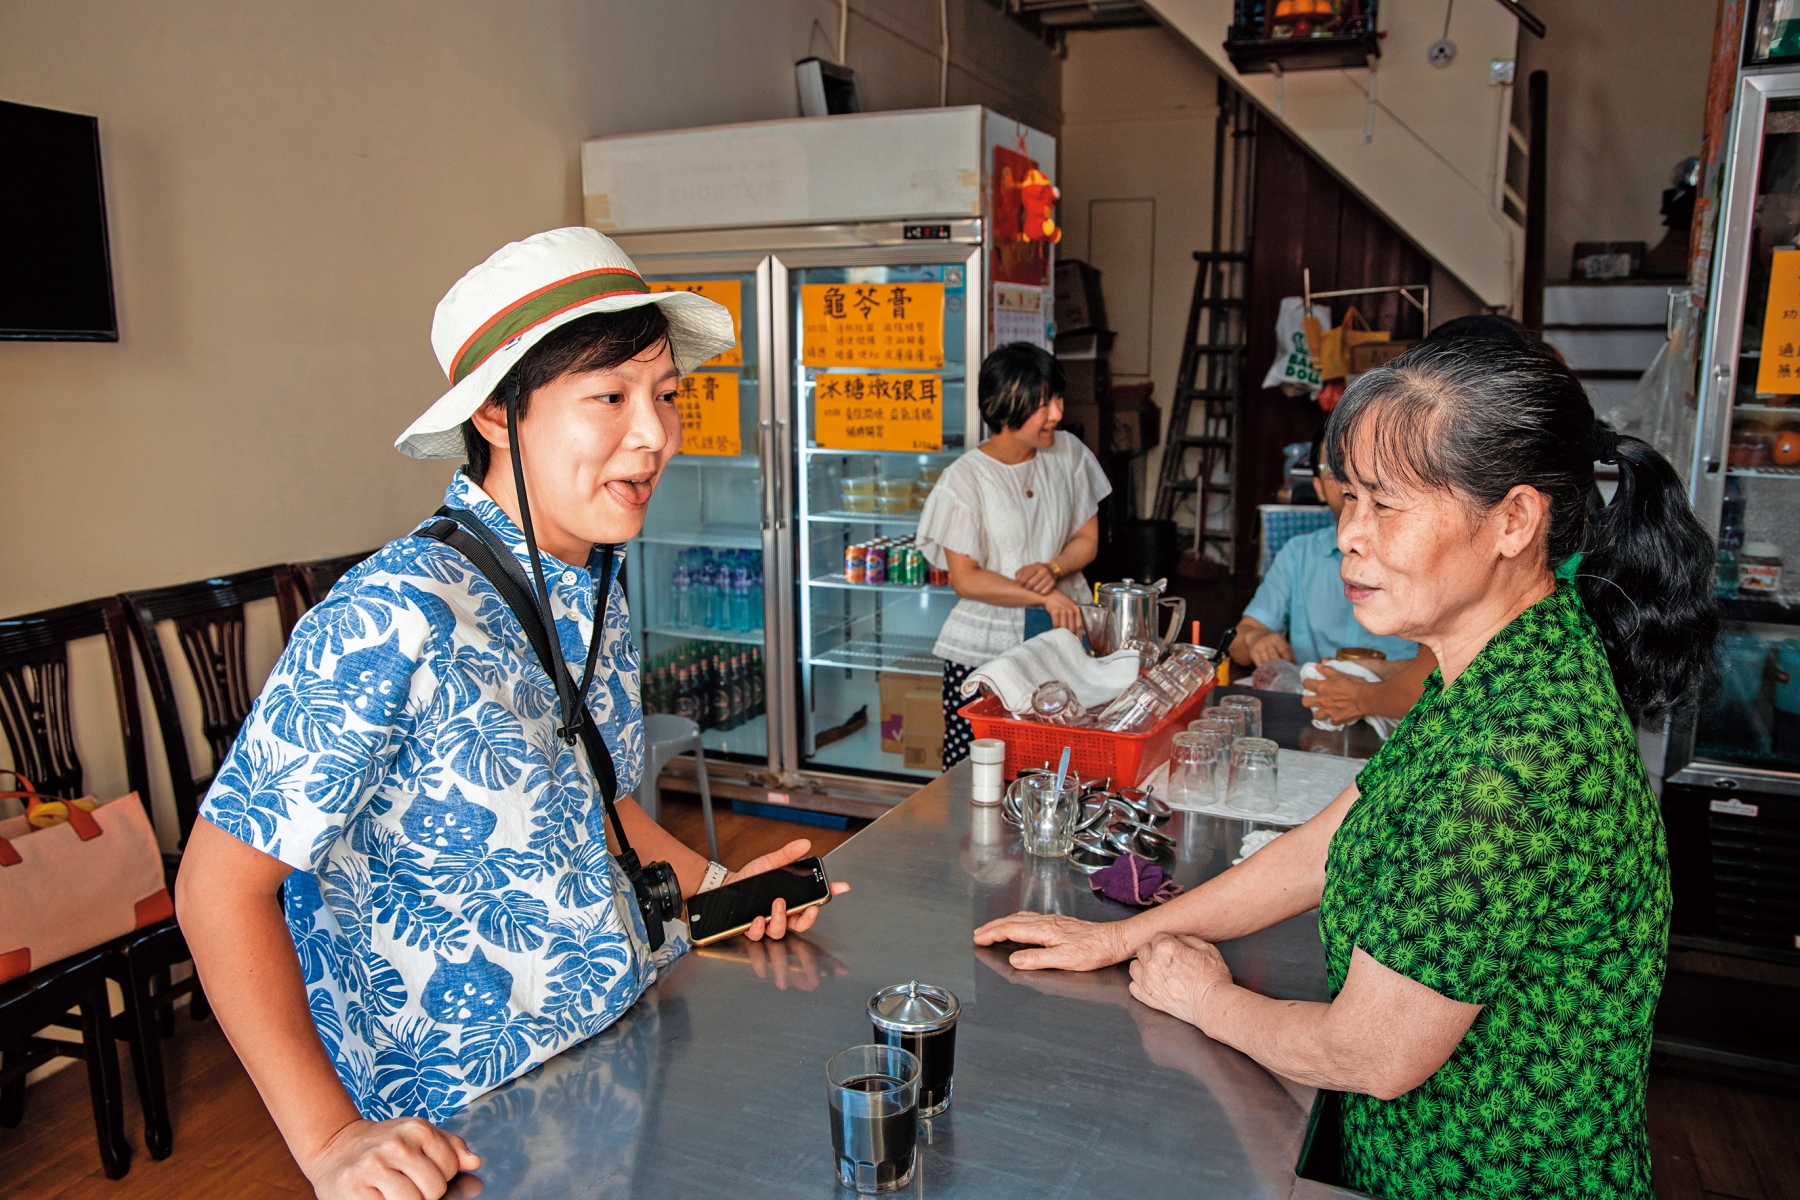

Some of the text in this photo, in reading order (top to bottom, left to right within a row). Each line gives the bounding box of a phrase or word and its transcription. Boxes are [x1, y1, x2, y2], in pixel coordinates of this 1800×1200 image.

[823, 286, 912, 320] 龜苓膏
[820, 377, 937, 404] 冰糖燉銀耳
[681, 434, 729, 452] 代經營
